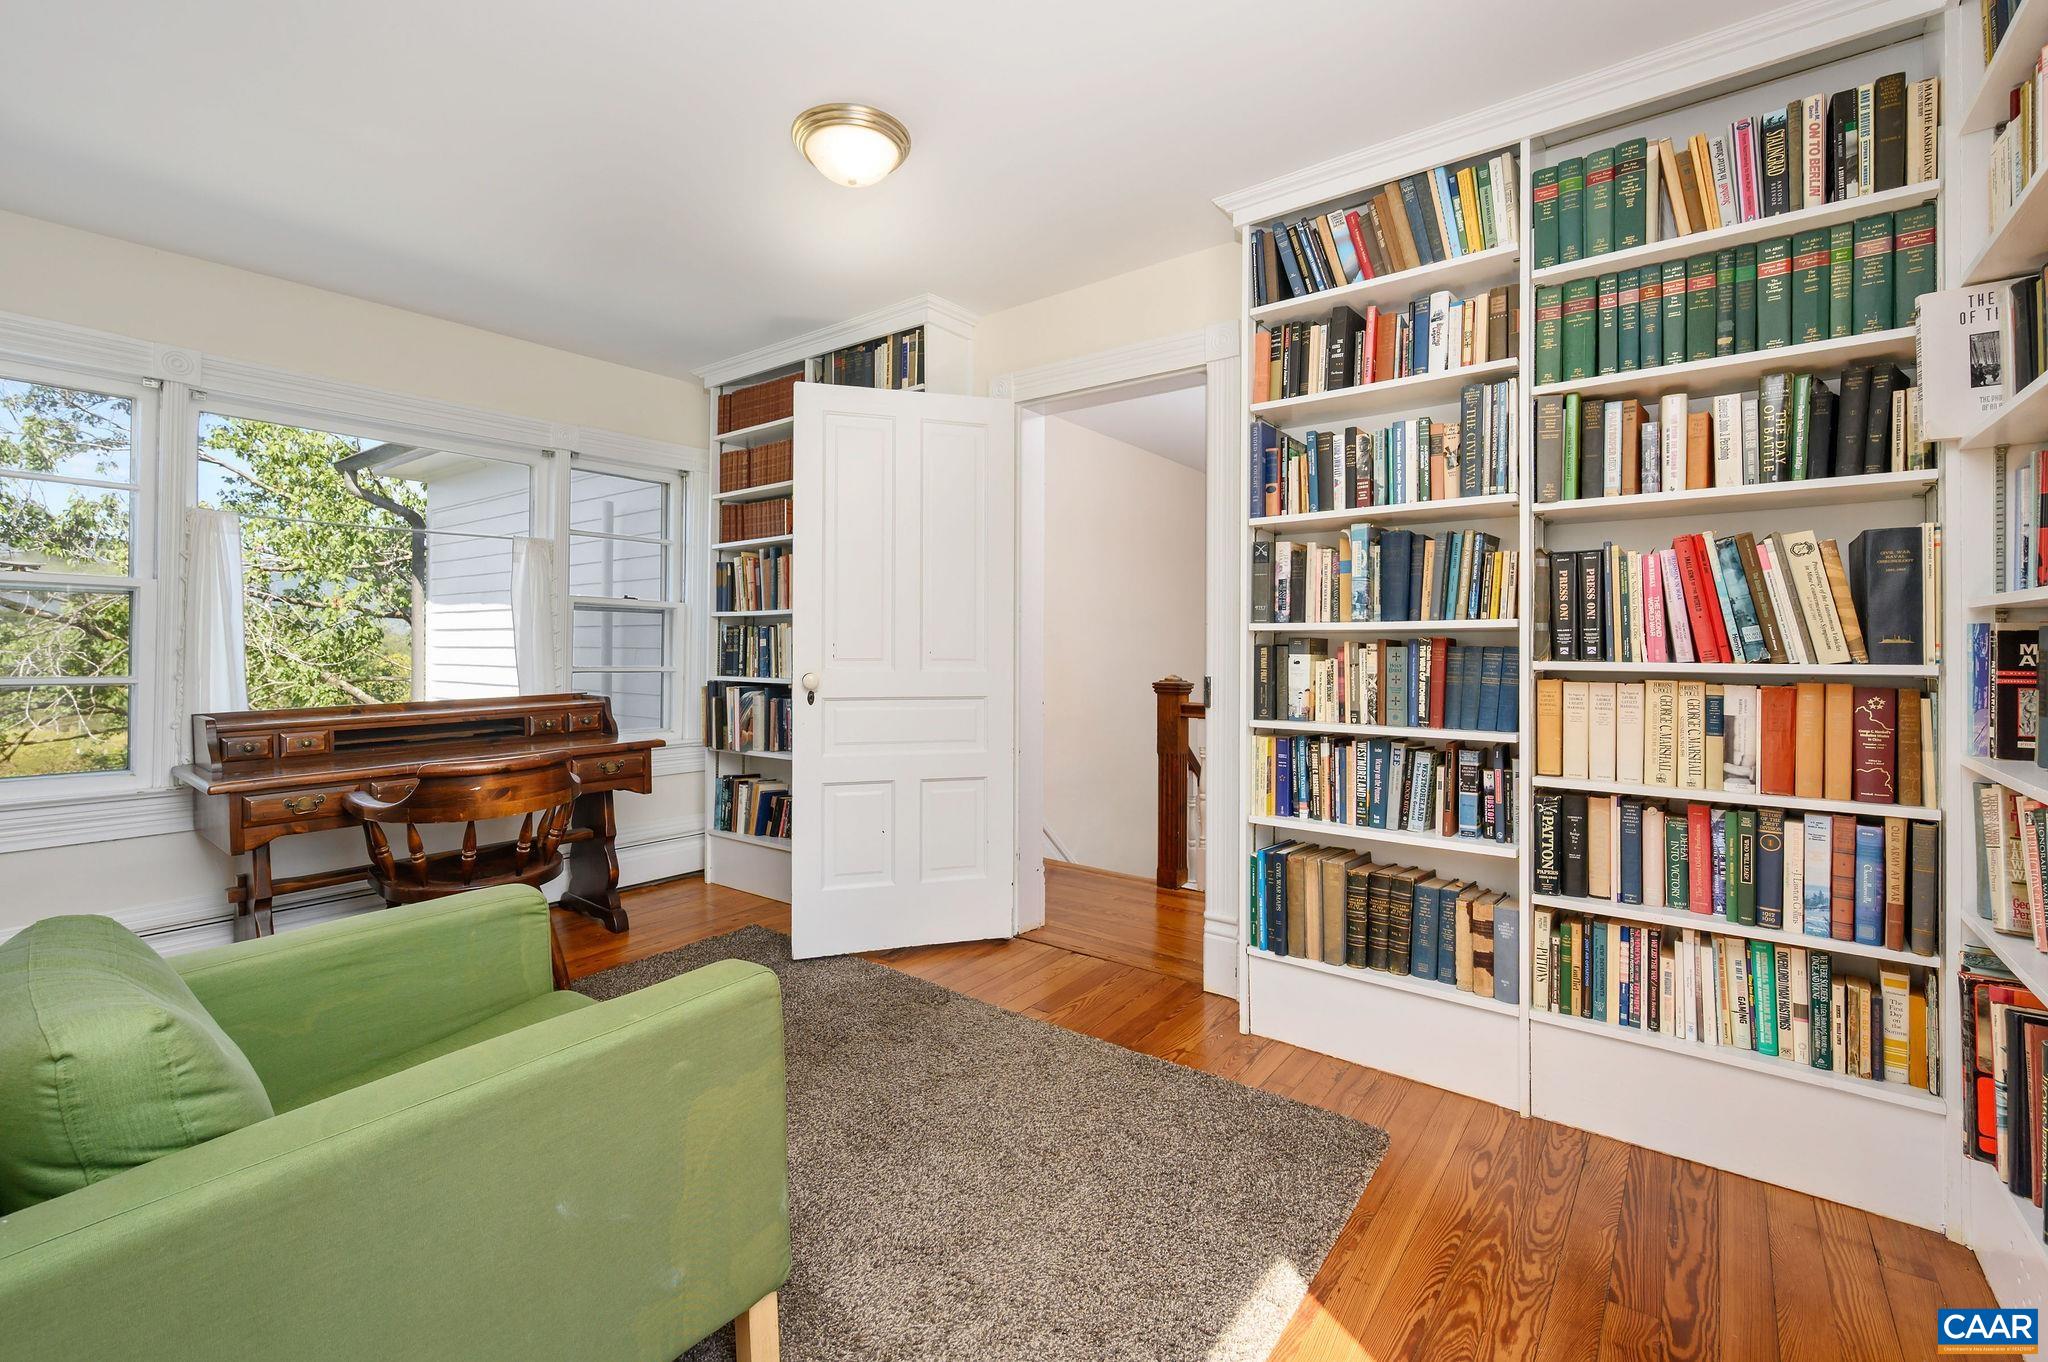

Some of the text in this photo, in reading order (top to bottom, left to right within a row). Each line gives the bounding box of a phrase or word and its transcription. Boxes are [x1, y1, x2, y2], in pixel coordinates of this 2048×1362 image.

[1766, 128, 1785, 177] STALINGRAD
[1809, 122, 1820, 197] ON TO BERLIN
[1924, 125, 1933, 155] KAISER
[1968, 292, 1995, 308] THE
[1465, 406, 1477, 490] THE CIVIL WAR
[1763, 404, 1774, 473] OF BATTLE
[1775, 409, 1787, 465] THE DAY
[1559, 569, 1569, 601] PRESS
[1586, 568, 1596, 599] PRESS
[1659, 695, 1673, 724] GEORGE
[1356, 742, 1367, 798] WESTMORELAND
[1392, 748, 1401, 767] LEE
[1658, 732, 1672, 773] MARSHALL
[1688, 736, 1702, 777] MARSHALL
[1417, 763, 1429, 822] WESTMORELAND
[1487, 795, 1495, 823] DUSTOFF
[1541, 815, 1554, 870] PATTON
[1680, 833, 1688, 862] DEFEAT
[1671, 841, 1680, 899] INTO VICTORY
[1891, 825, 1900, 903] OUR ARMY AT WAR
[1536, 947, 1548, 983] PATTONS
[1779, 1001, 1791, 1031] HASTINGS
